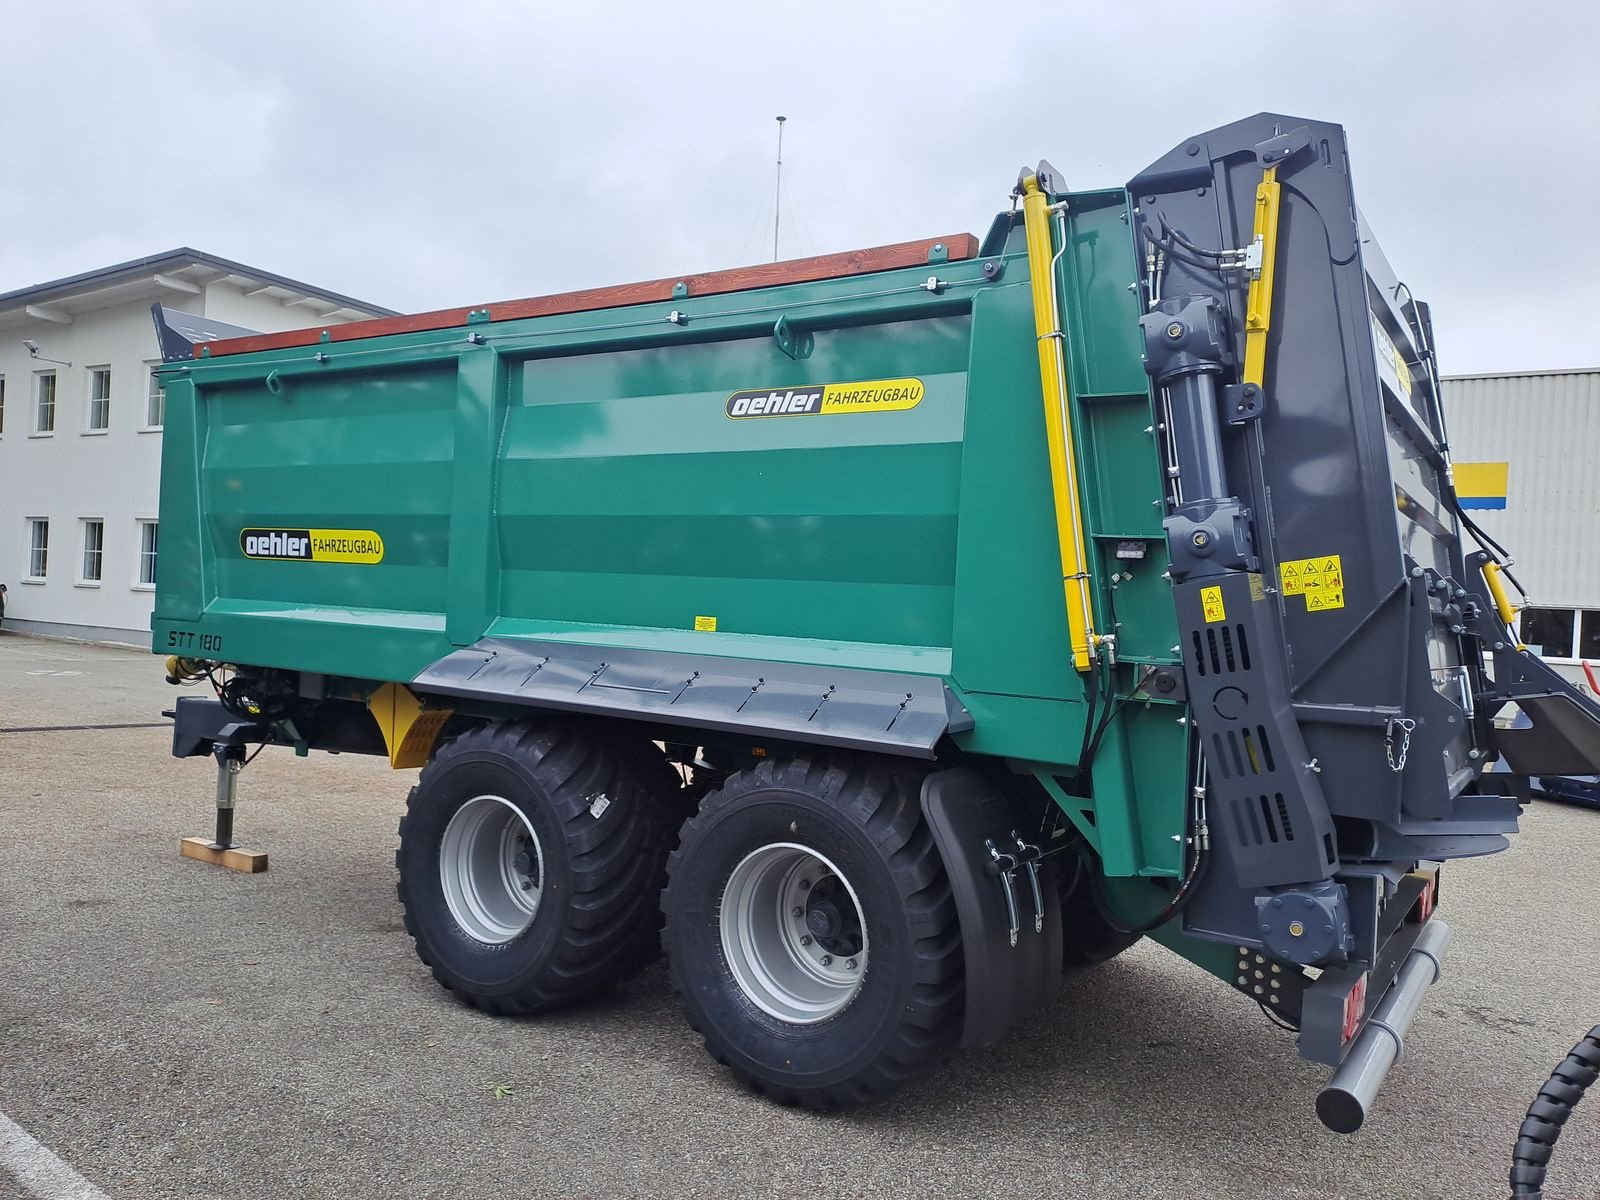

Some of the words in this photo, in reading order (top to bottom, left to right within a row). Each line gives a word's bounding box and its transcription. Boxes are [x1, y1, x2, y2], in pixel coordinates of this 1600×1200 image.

[731, 391, 821, 416] oehler
[825, 386, 921, 405] FAHRZEUGBAU
[246, 532, 309, 557] oehler
[313, 538, 381, 554] FAHRZEUGBAU
[168, 631, 195, 648] STT
[199, 634, 222, 651] 180
